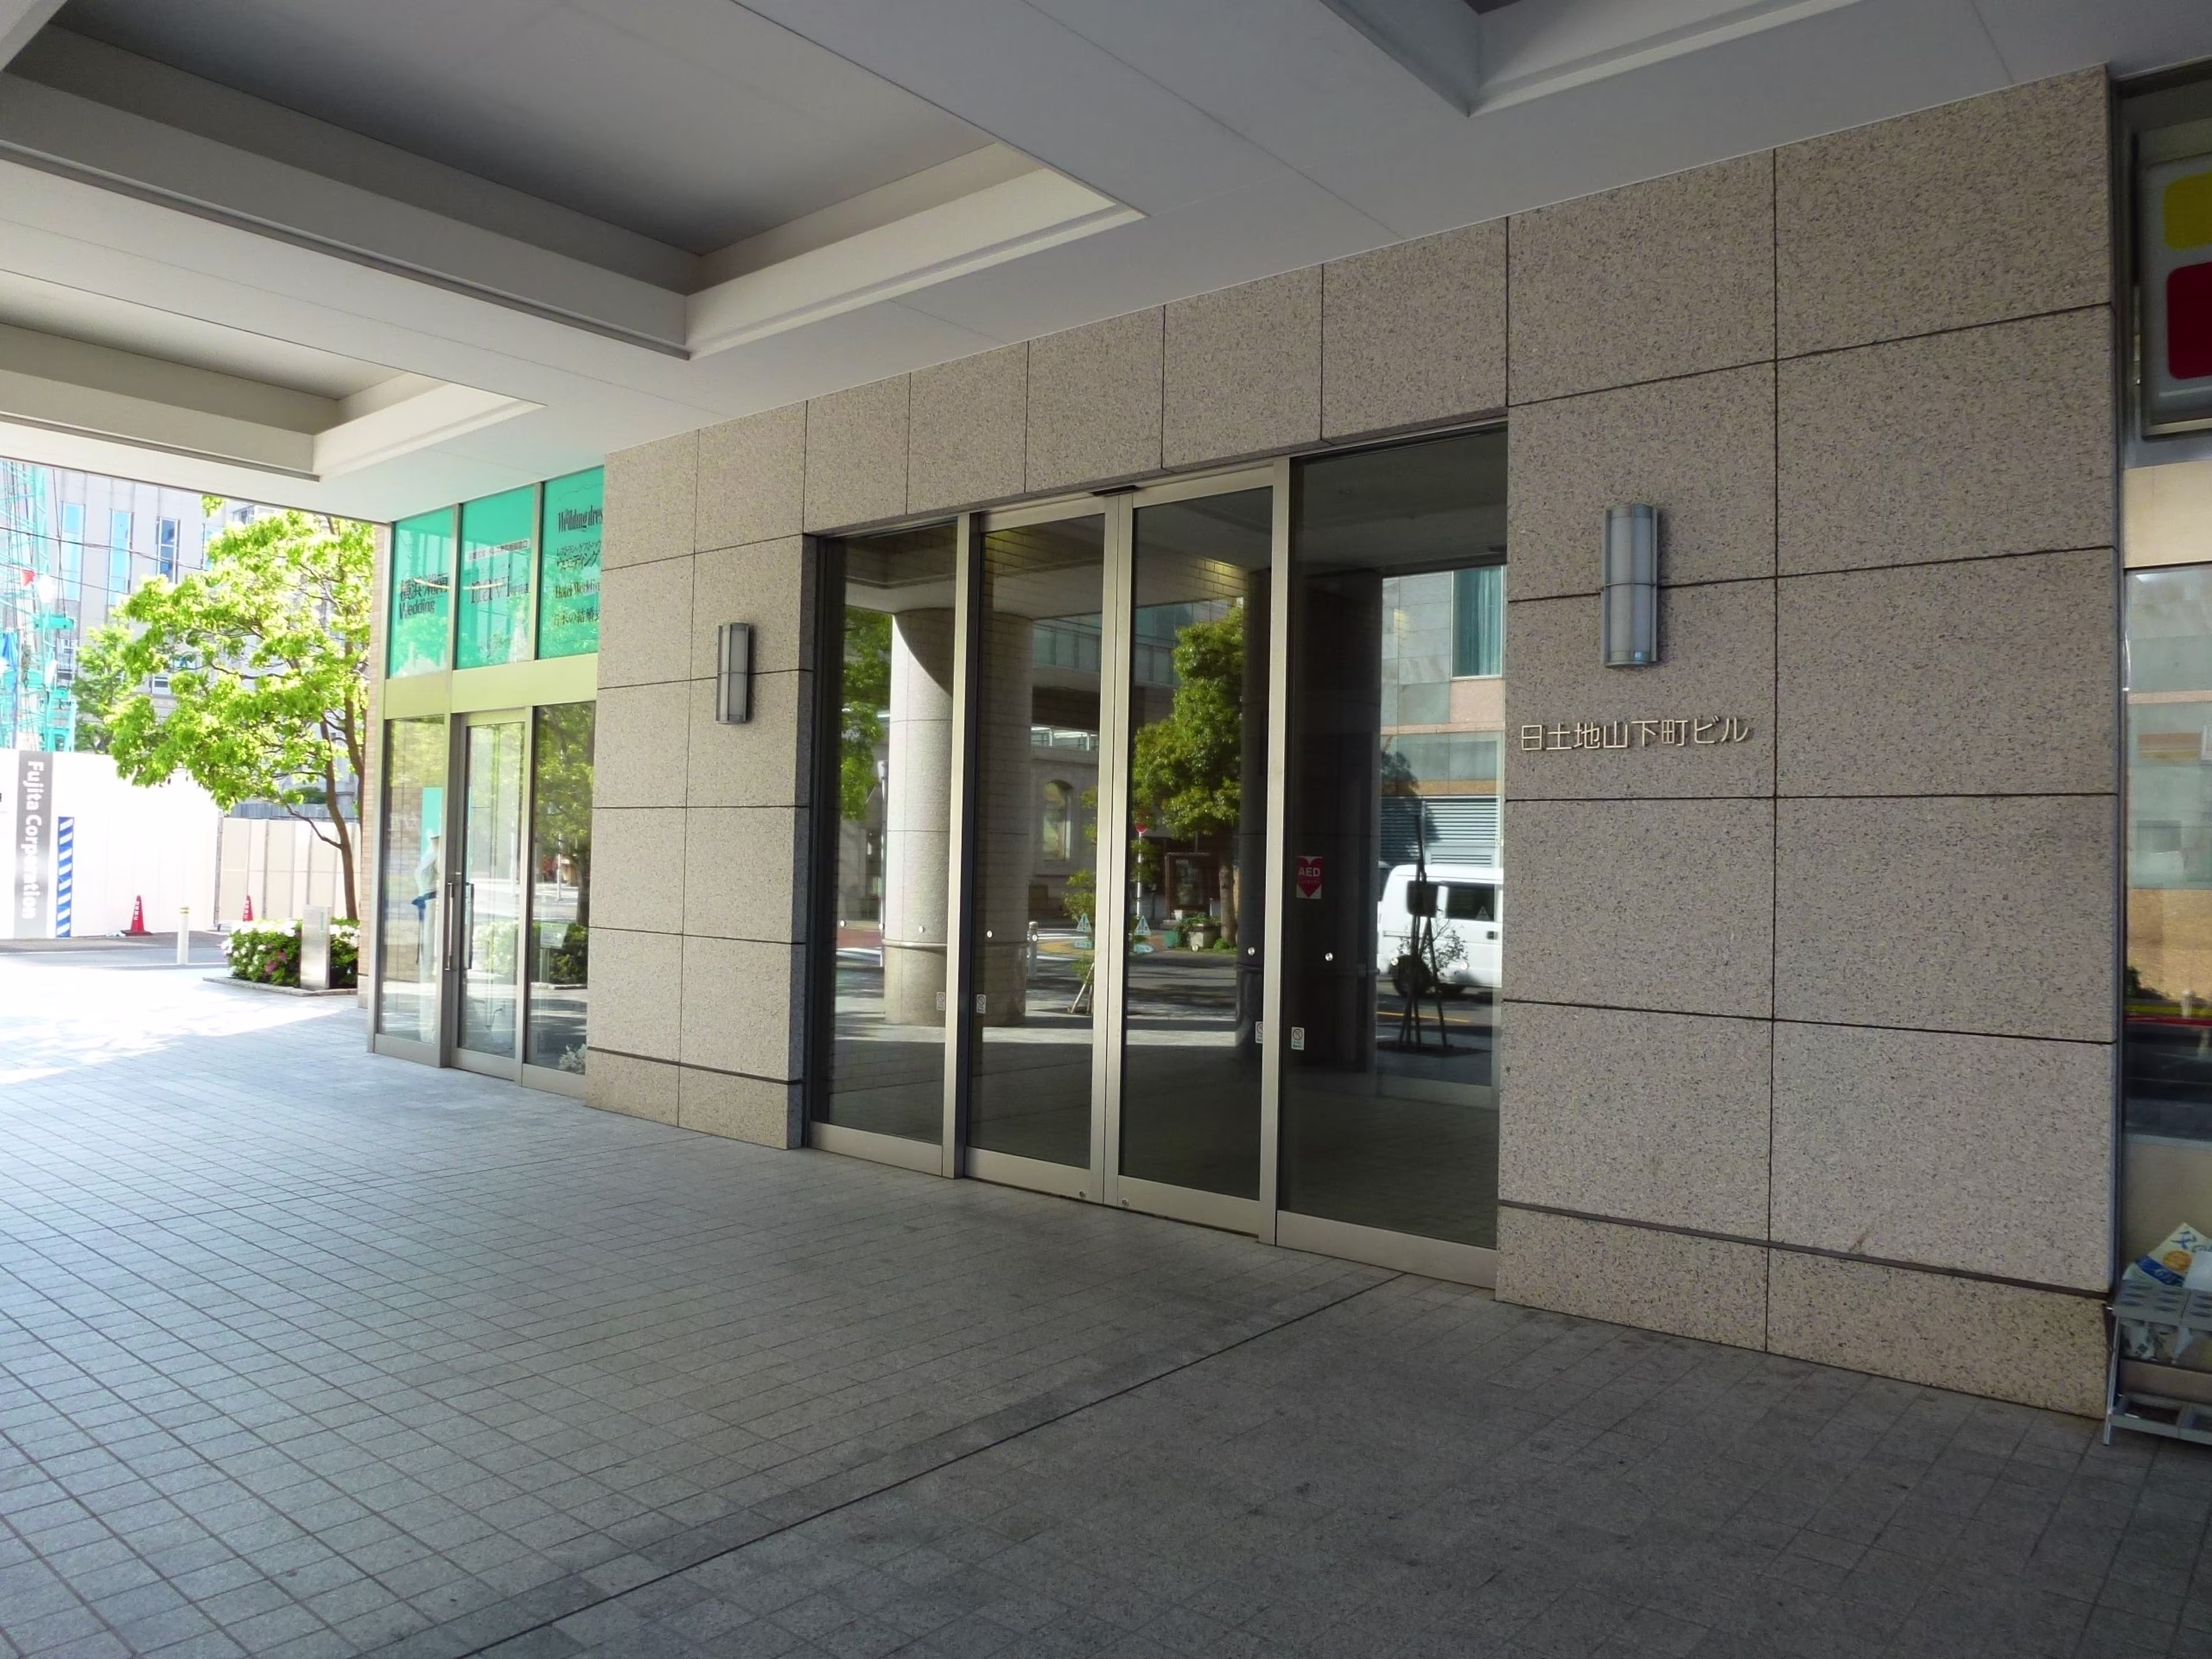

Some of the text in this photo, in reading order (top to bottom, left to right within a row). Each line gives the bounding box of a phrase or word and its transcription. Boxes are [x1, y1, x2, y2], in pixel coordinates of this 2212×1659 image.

[559, 509, 588, 533] Wedding
[400, 599, 435, 619] Wedding
[1521, 715, 1749, 752] 日土地山下町ビル
[22, 761, 44, 810] Fujita
[21, 815, 42, 918] Corporation
[1298, 867, 1321, 876] AED
